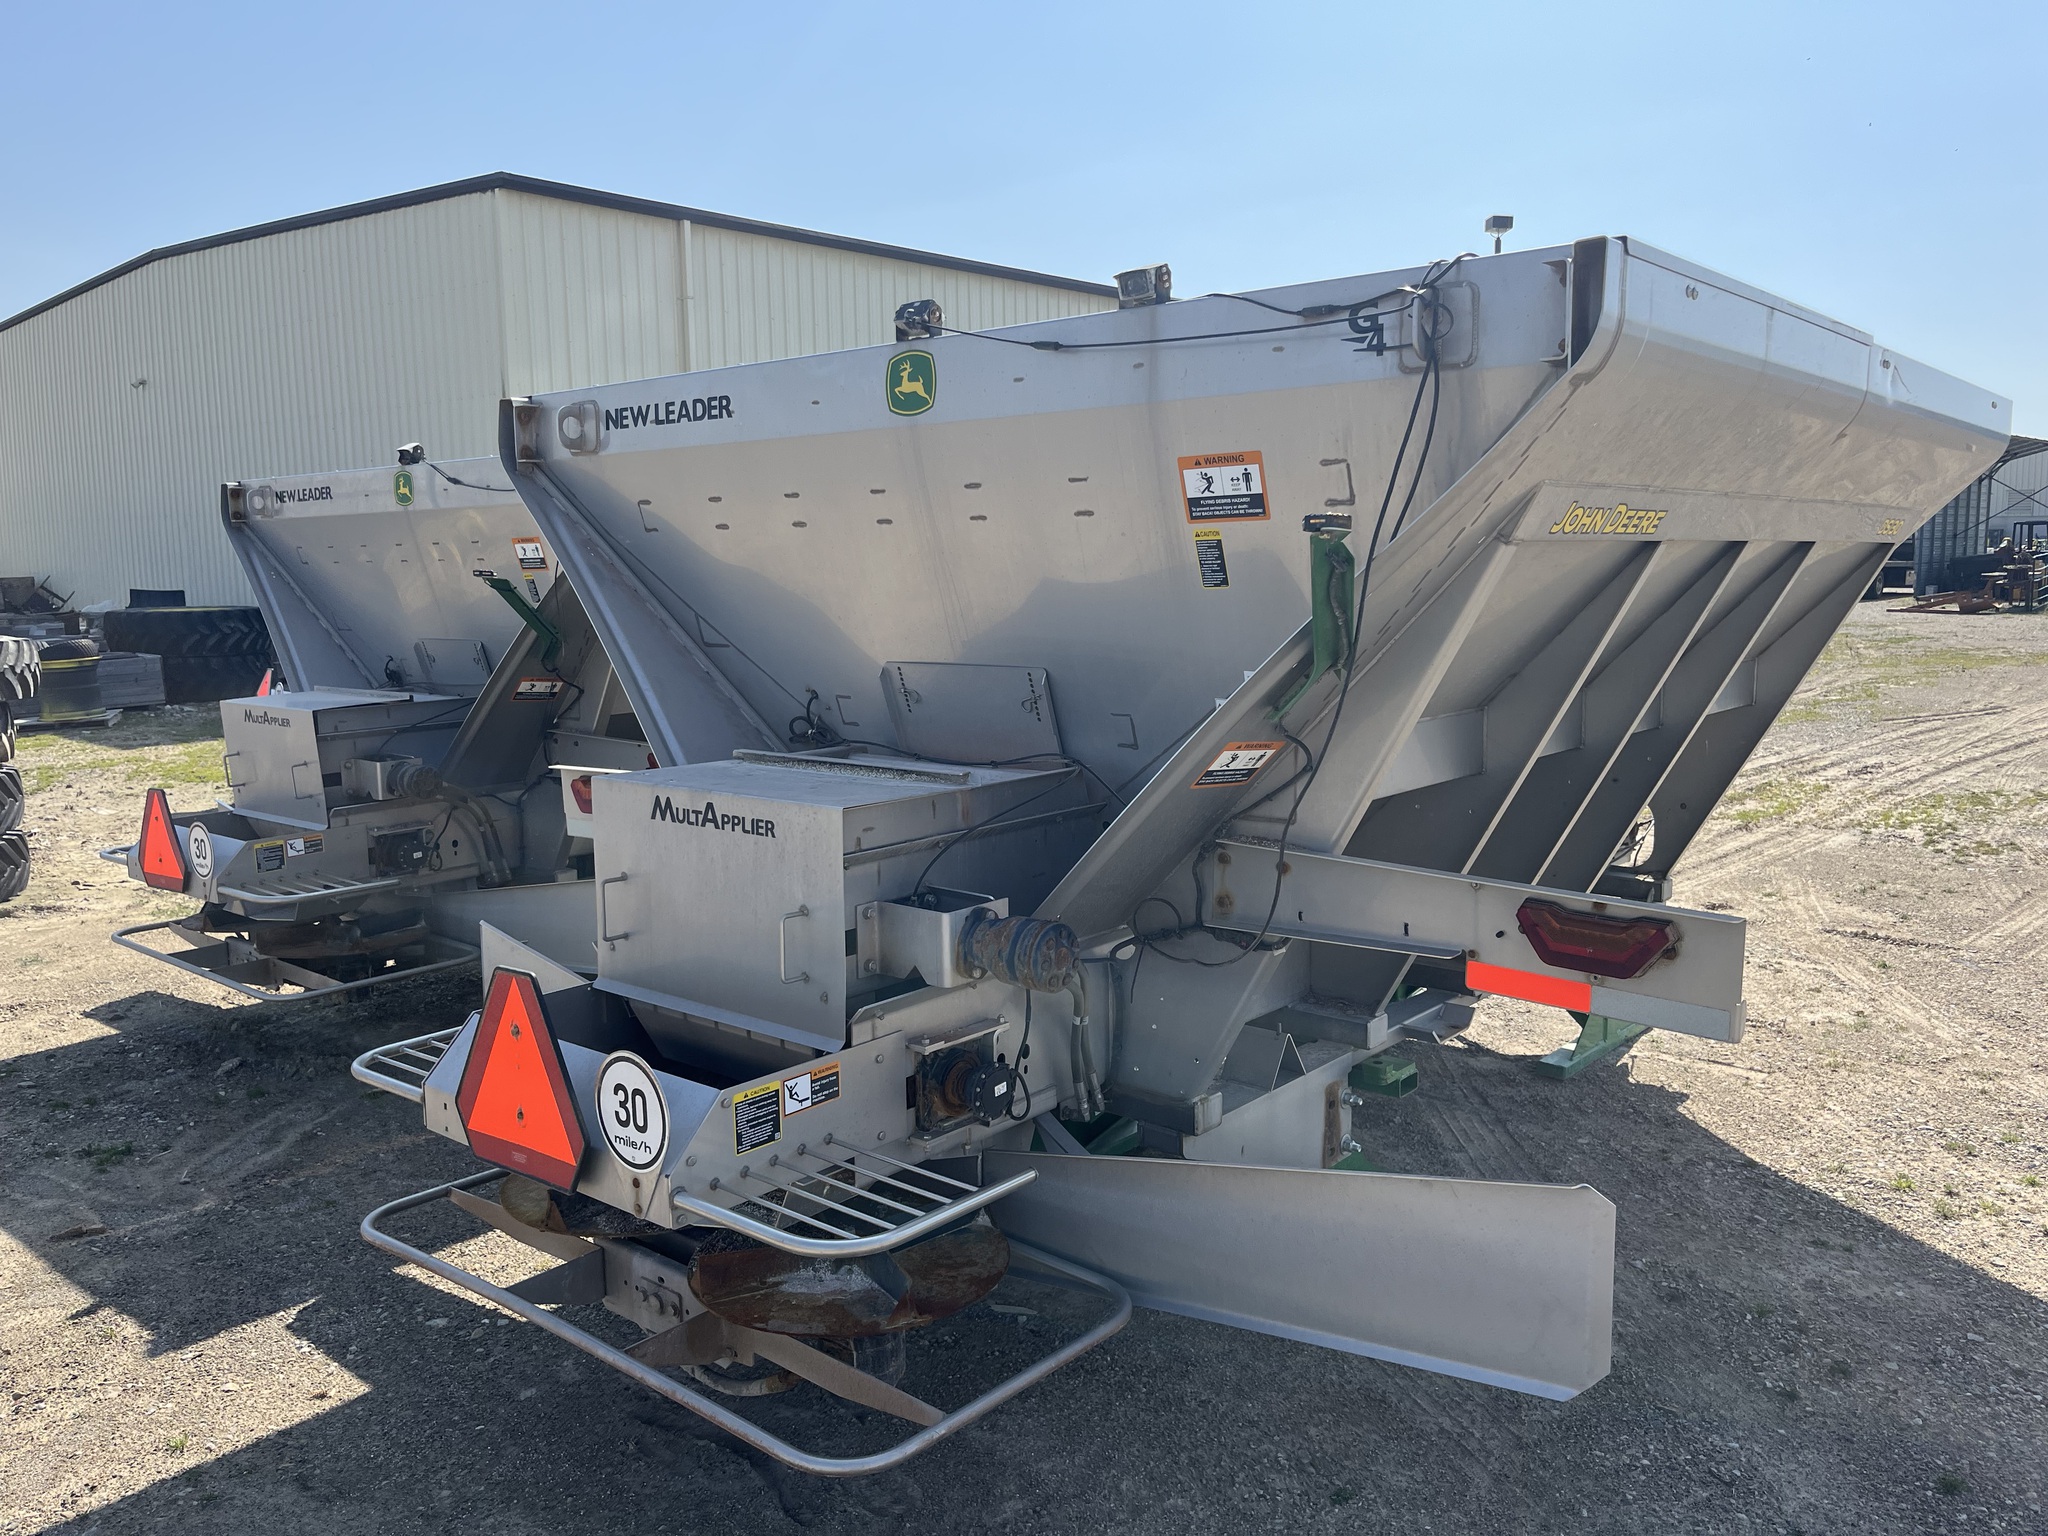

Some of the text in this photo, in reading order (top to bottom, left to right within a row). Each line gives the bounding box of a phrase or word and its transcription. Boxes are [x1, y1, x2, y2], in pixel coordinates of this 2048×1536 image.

[605, 395, 733, 431] NEW LEADER
[1203, 454, 1245, 466] WARNING
[275, 486, 333, 504] NEW LEADER
[1548, 500, 1668, 535] JOHN DEERE
[1200, 530, 1220, 538] CAUTION
[194, 837, 207, 861] 30
[749, 1085, 771, 1097] CAUTION
[613, 1082, 649, 1134] 30
[614, 1134, 652, 1155] mile/h
